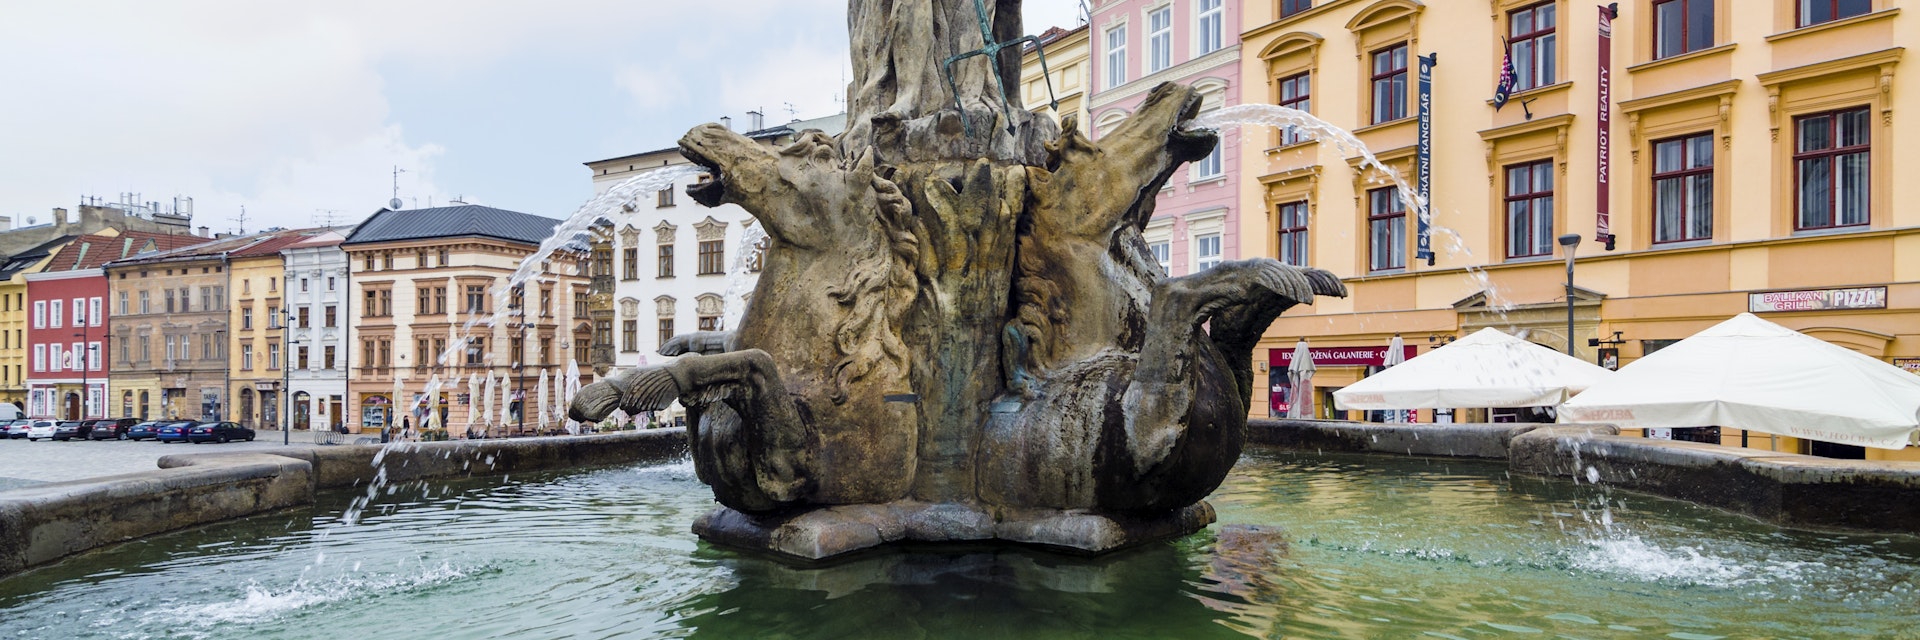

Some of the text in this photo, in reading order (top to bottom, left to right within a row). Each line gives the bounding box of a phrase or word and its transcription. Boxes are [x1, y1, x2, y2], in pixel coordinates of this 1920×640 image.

[1599, 66, 1608, 184] PATRIOT REALITY
[1420, 93, 1429, 224] DVOKÁTNÍ KANCELÁŘ
[1763, 291, 1824, 303] BALLKAN
[1834, 290, 1878, 307] PIZZA
[1774, 300, 1812, 310] GRILL
[1309, 350, 1332, 360] OŽENÁ
[1333, 350, 1374, 359] GALANTERIE
